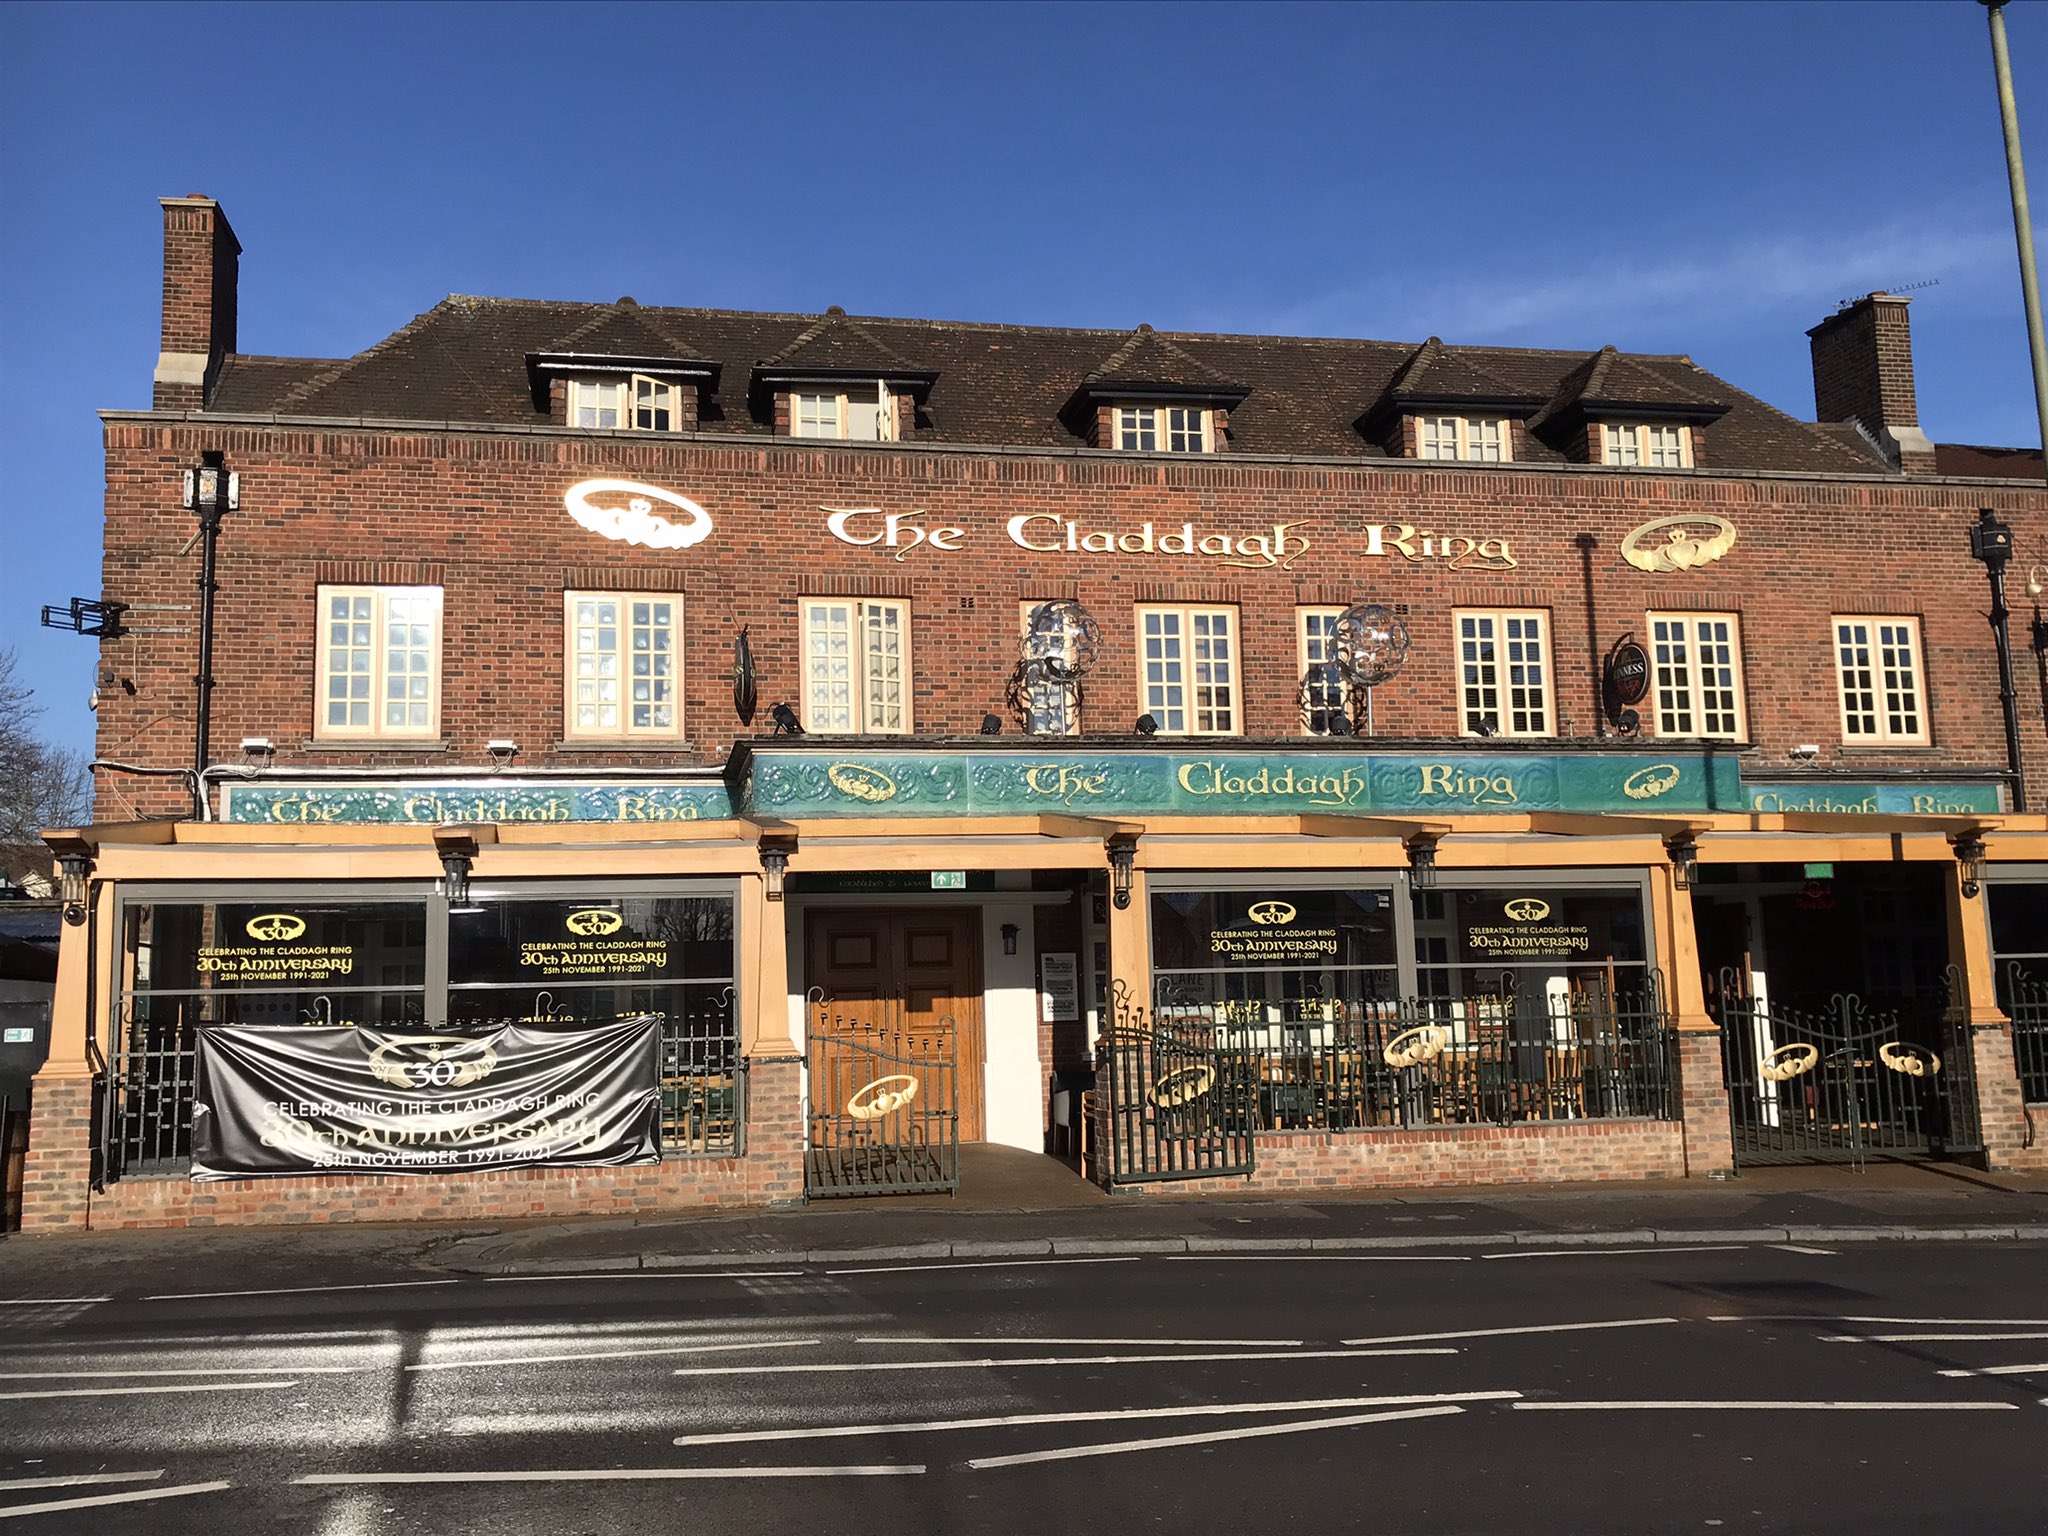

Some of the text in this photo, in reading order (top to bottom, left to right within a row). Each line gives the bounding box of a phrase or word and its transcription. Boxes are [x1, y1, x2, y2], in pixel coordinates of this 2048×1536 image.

[819, 505, 1518, 572] The Claddagh Ring
[1021, 761, 1518, 806] The Claddagh Ring
[269, 796, 342, 822] The
[1211, 940, 1244, 951] 30th
[1469, 936, 1500, 947] 30th
[198, 948, 256, 956] CELEBRATING
[260, 947, 275, 955] THE
[277, 947, 327, 955] CLADDAGH
[197, 958, 237, 971] 30th
[520, 952, 558, 965] 30th
[241, 972, 286, 980] NOVEMBER
[543, 966, 560, 974] 25th
[263, 1092, 600, 1117] CELEBRATING THE CLADDAGH RING
[312, 1146, 551, 1168] 25th NOVEMBER 1991-2021
